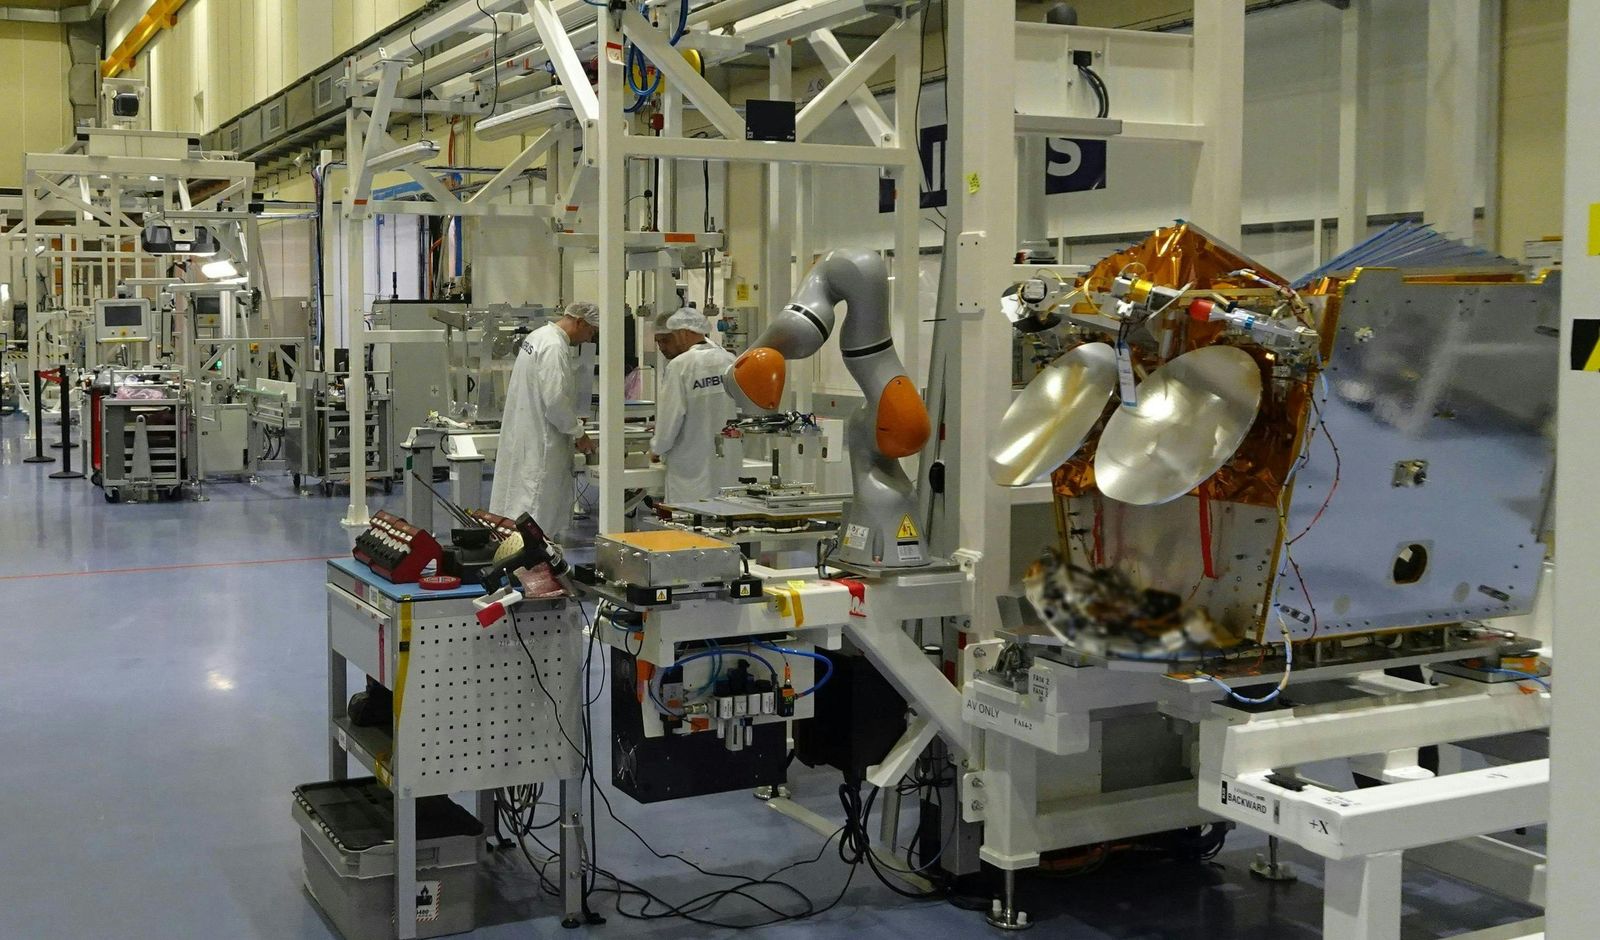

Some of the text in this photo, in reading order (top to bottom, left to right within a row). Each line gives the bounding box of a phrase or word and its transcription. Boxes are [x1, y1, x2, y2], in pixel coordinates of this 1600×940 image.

[693, 375, 723, 390] AIRB
[966, 699, 1000, 718] AV ONLY
[1228, 793, 1267, 814] BACKWARD
